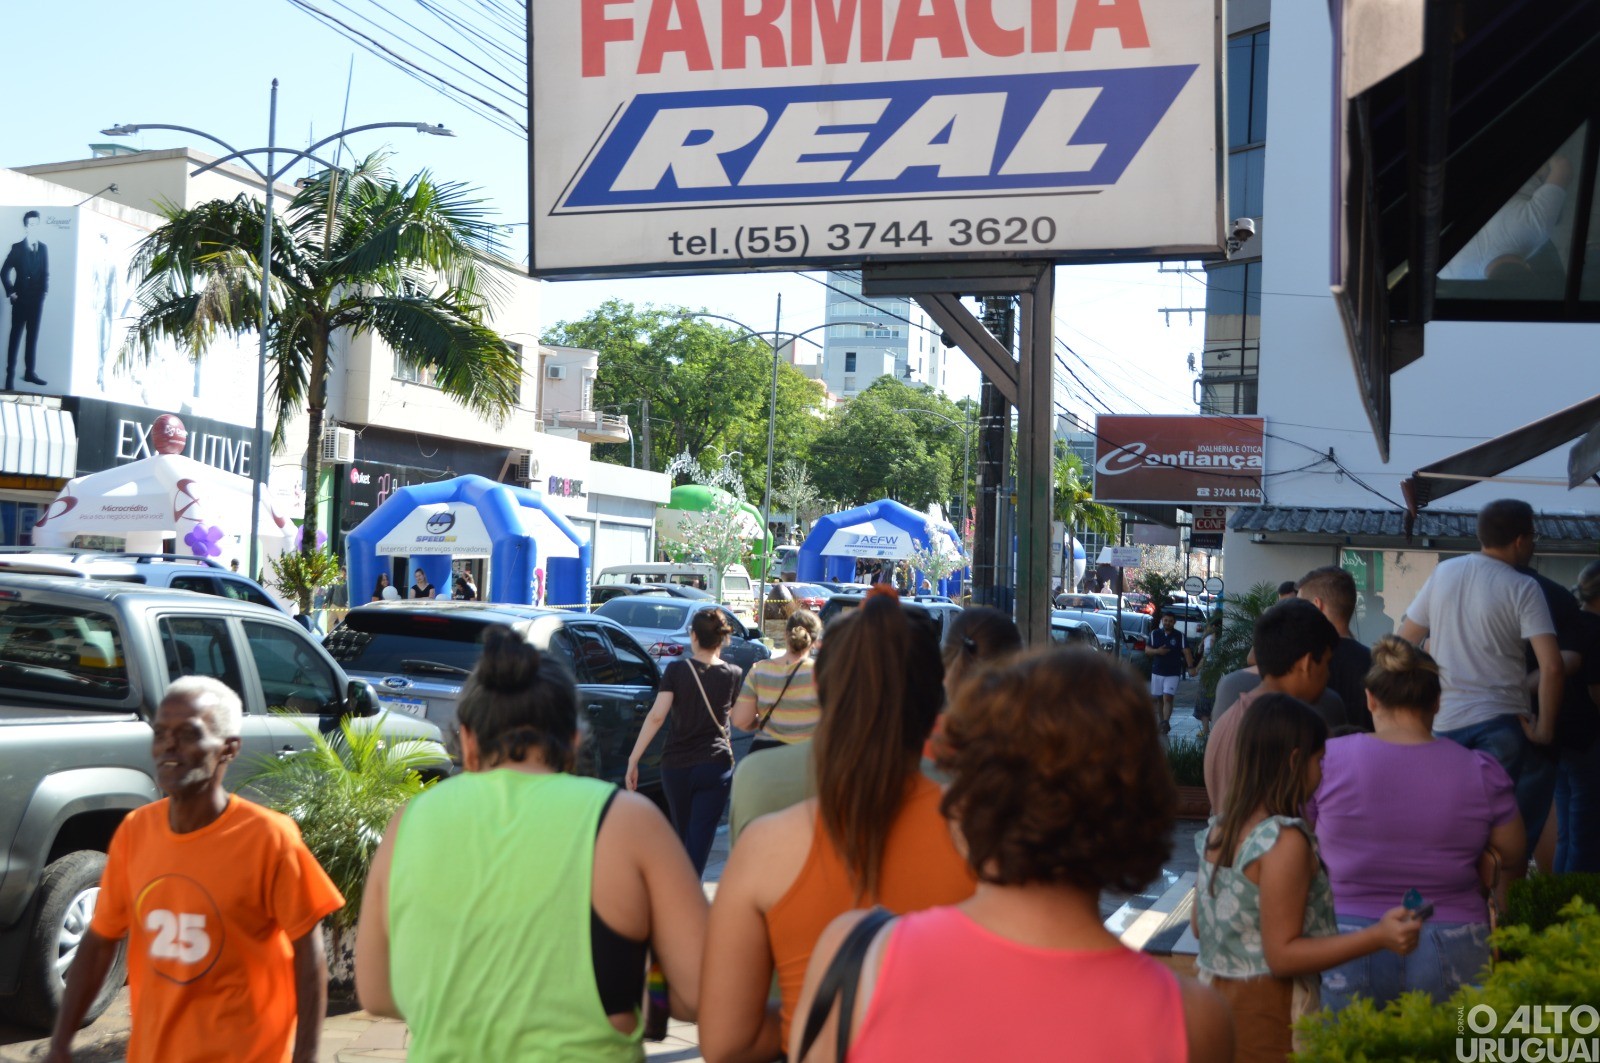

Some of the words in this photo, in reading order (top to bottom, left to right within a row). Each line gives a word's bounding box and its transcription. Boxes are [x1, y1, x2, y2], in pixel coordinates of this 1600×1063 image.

[608, 86, 1108, 192] REAL
[826, 221, 932, 252] 3744
[948, 215, 1057, 248] 3620
[116, 418, 252, 477] EXUTIVE
[1197, 445, 1234, 453] JOALHERIA
[1241, 444, 1262, 453] ÓTICA
[1096, 442, 1262, 476] Confiança
[1213, 488, 1236, 497] 3744
[1239, 488, 1262, 498] 1442
[101, 504, 149, 512] Microcrédito
[424, 545, 451, 553] serviços
[453, 545, 488, 553] inovadores
[860, 535, 899, 544] AEFW
[145, 909, 211, 965] 25
